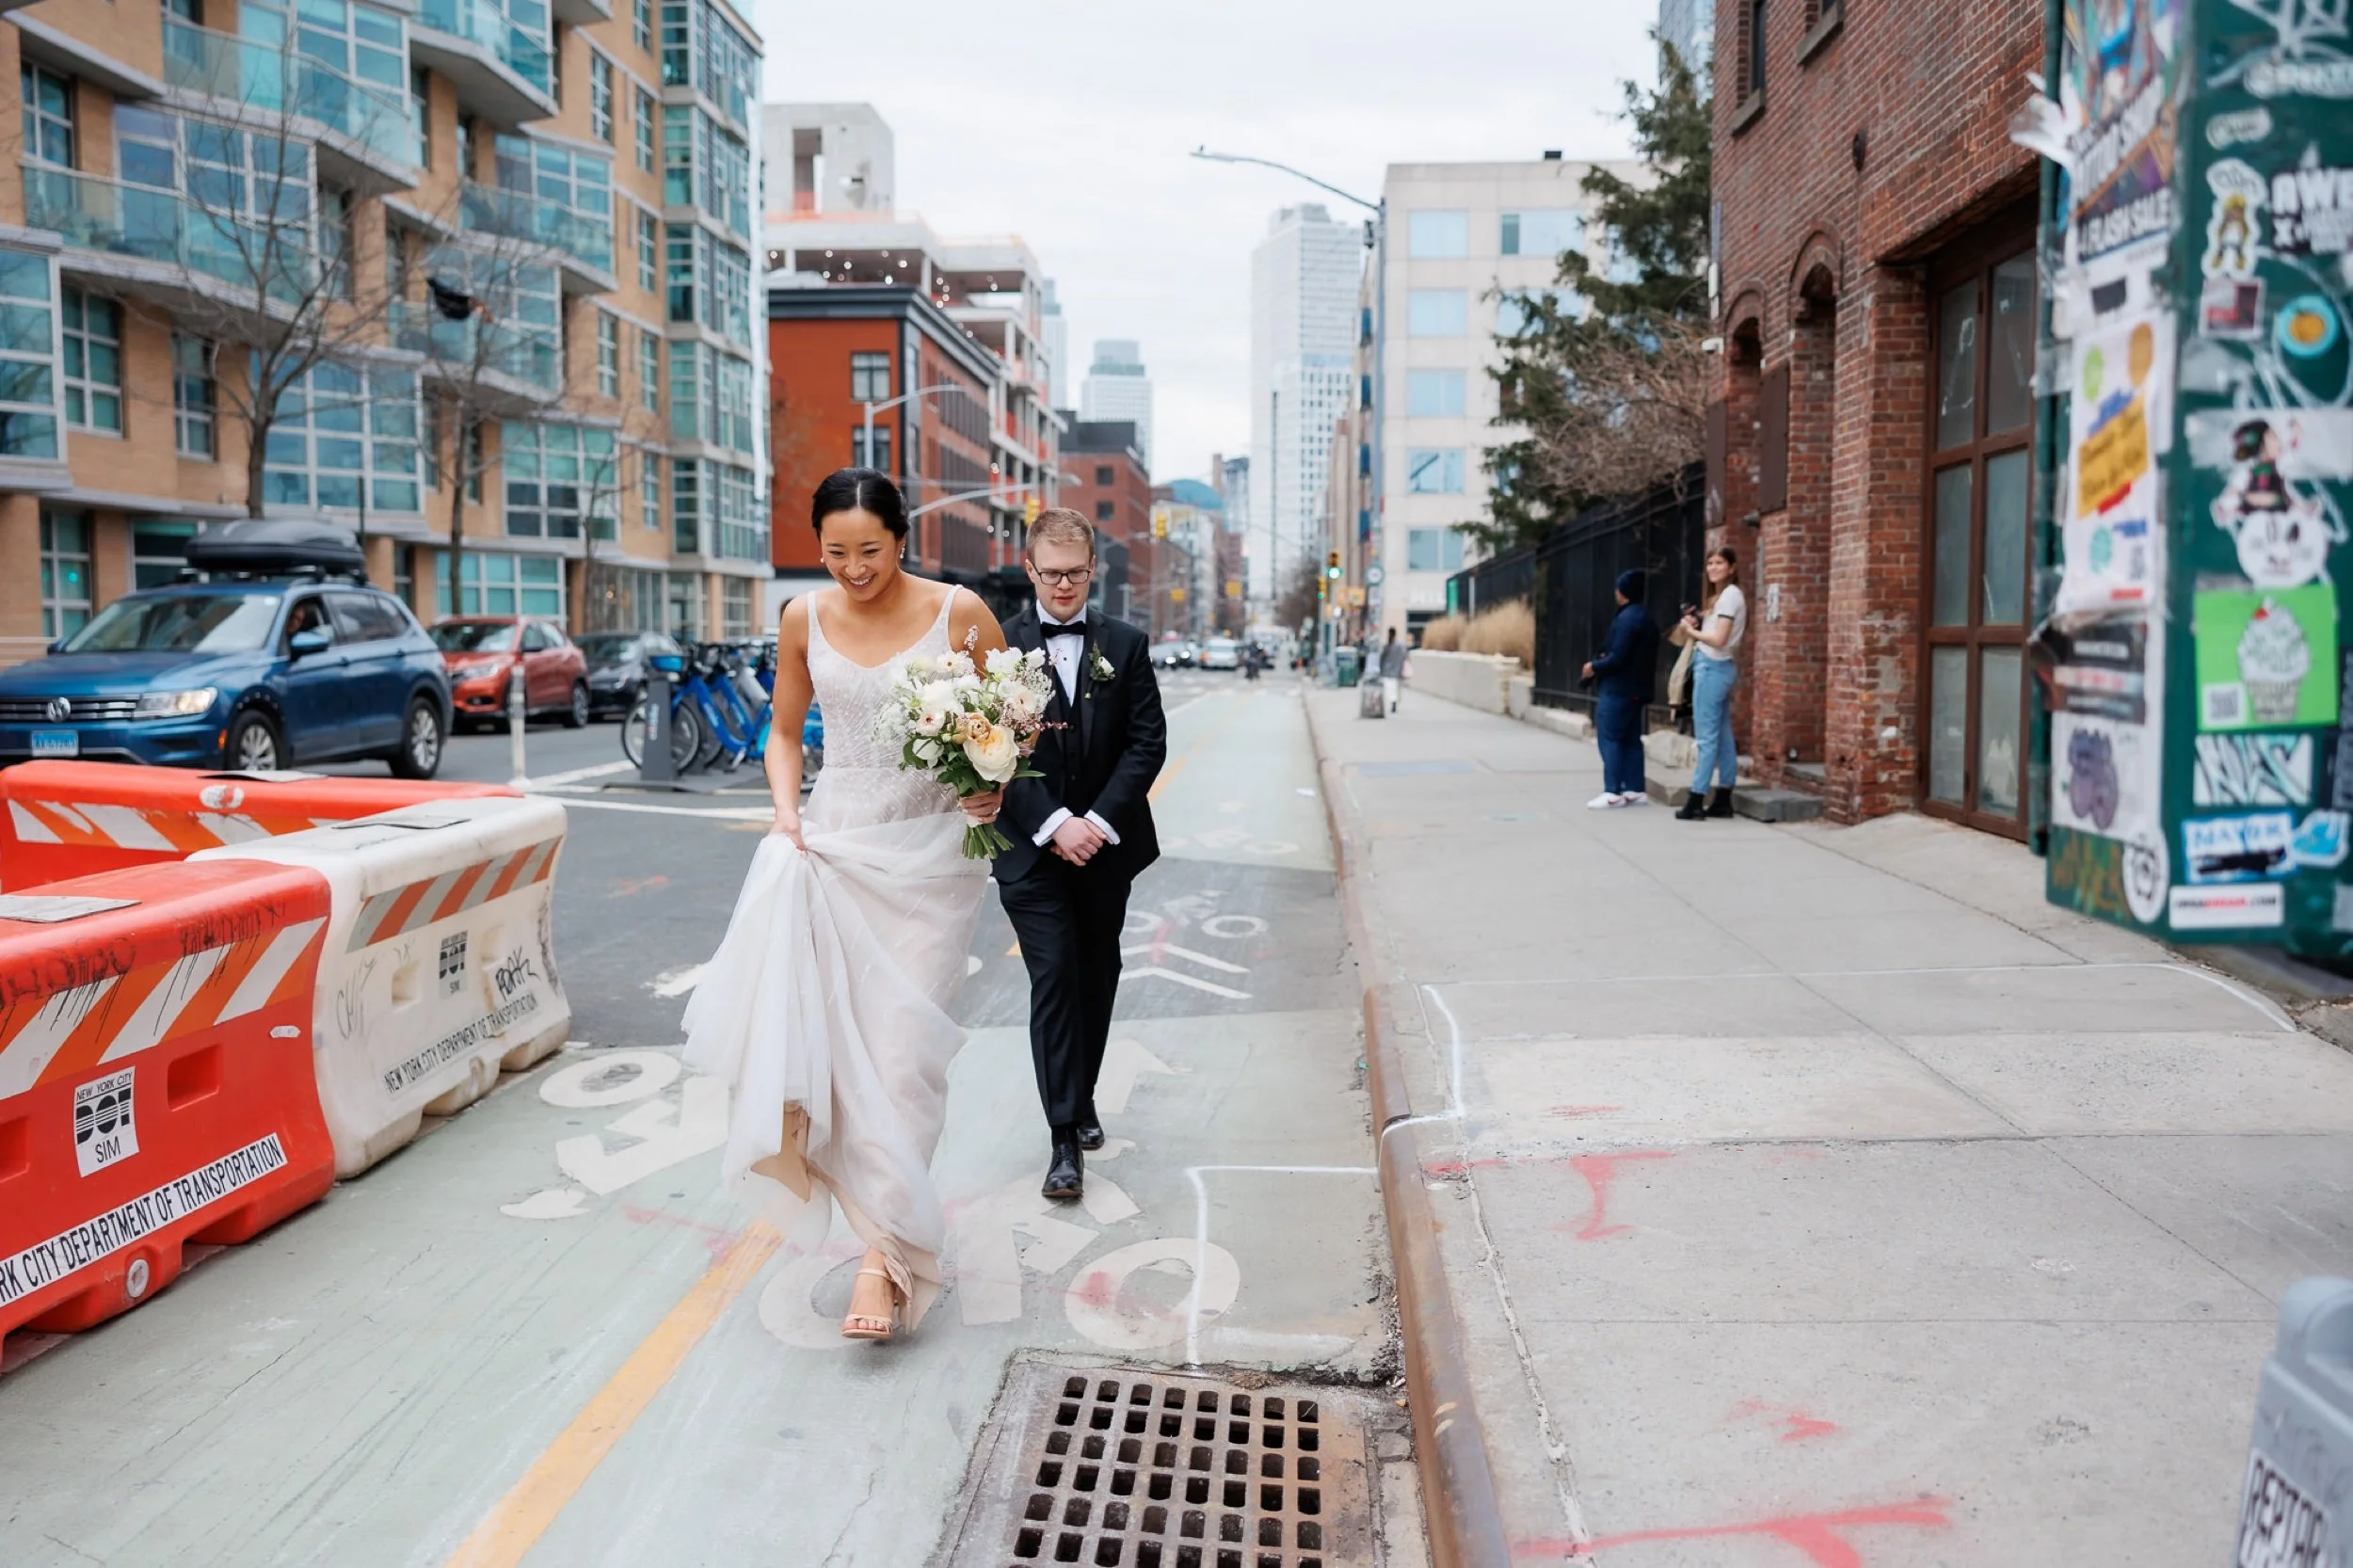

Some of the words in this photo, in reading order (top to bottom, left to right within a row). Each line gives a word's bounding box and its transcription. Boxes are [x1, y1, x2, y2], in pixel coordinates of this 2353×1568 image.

[76, 1086, 93, 1101] NEW
[97, 1078, 115, 1093] YORK
[117, 1071, 133, 1085] CITY
[384, 1066, 404, 1094] NEW
[401, 1056, 425, 1083] YORK
[421, 1046, 440, 1072] CITY
[437, 1023, 479, 1062] DEPARTMENT
[75, 1087, 132, 1145] DOT
[95, 1136, 121, 1163] SIM
[22, 1240, 61, 1288] CITY
[60, 1196, 157, 1271] DEPARTMENT
[155, 1187, 175, 1222] OF
[176, 1135, 284, 1213] TRANSPORTATION
